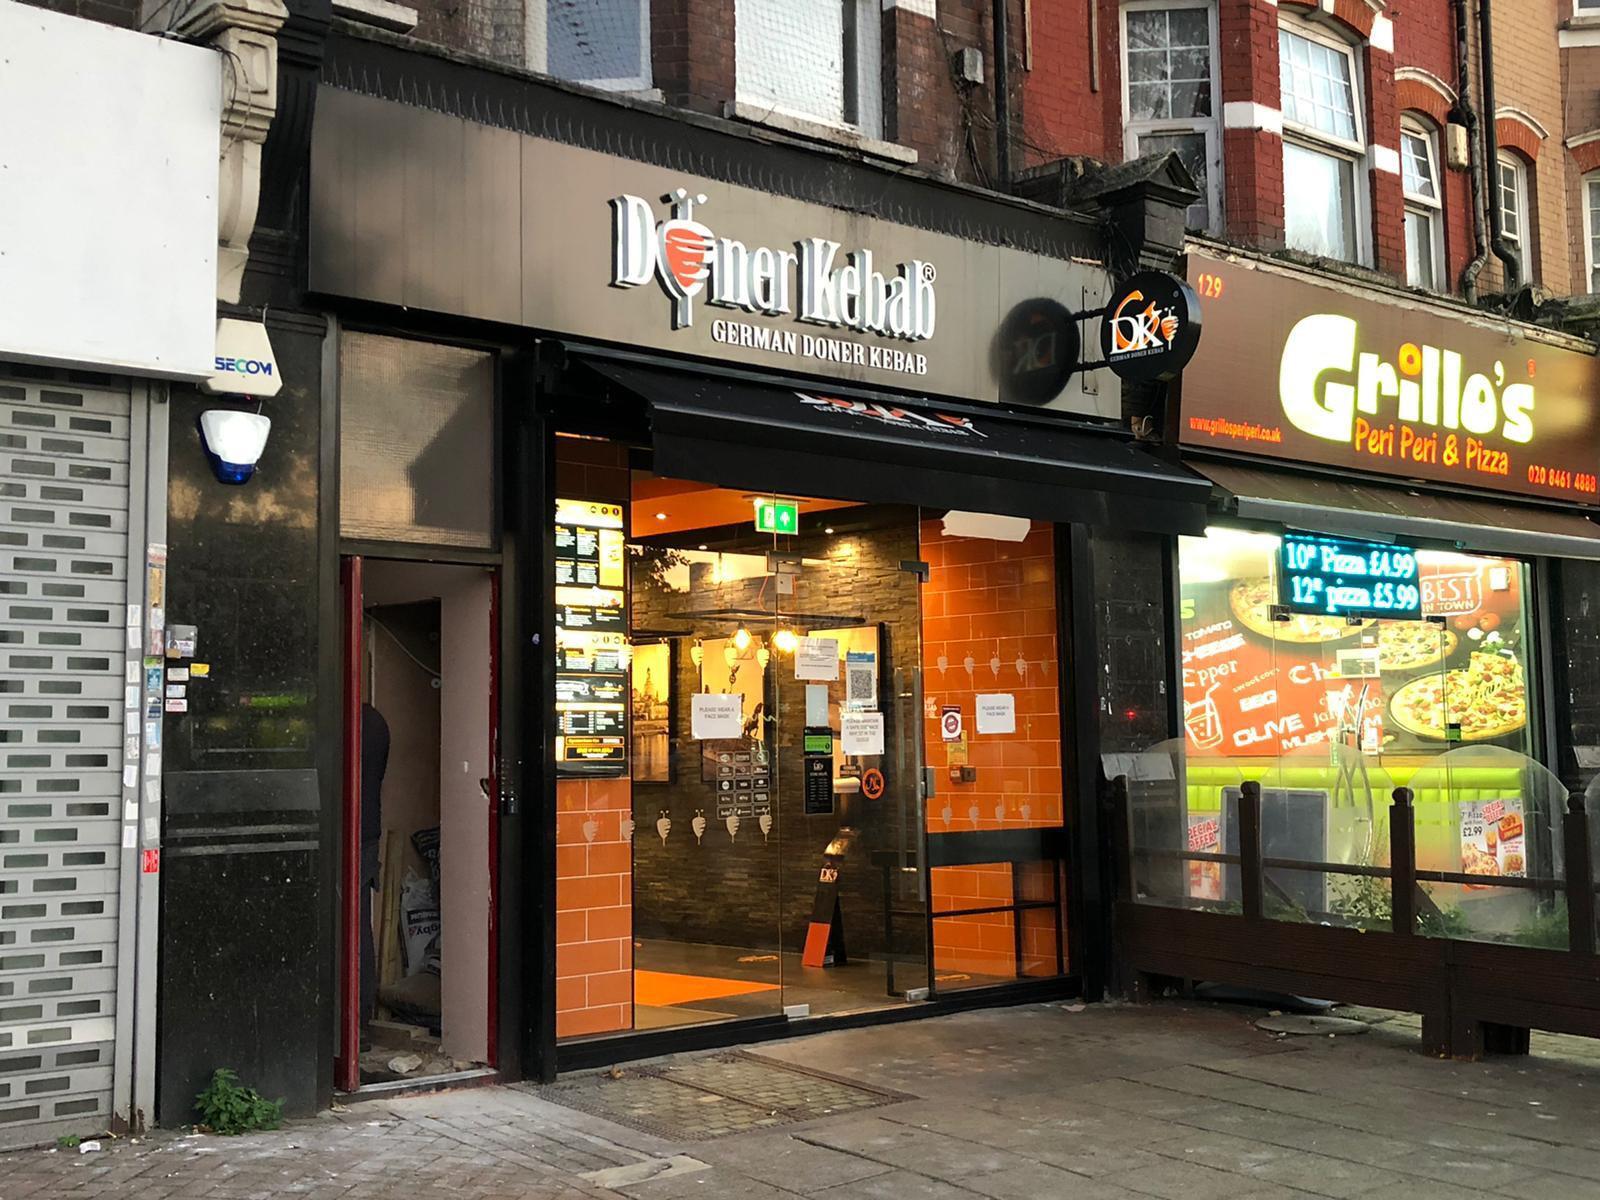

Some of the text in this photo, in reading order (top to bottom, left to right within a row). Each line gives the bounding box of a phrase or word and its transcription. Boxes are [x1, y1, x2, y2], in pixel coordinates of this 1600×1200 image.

[1198, 273, 1223, 299] 129
[711, 318, 928, 376] GERMAN DONER KEBAB
[214, 356, 273, 377] SECOM
[1279, 313, 1536, 444] Grillo's
[1355, 416, 1510, 476] Peri Peri & Pizza
[1527, 463, 1598, 494] 020 8461 4888
[1319, 544, 1368, 576] Pizza
[1369, 550, 1416, 579] £4.99
[1325, 577, 1372, 614] pizza
[1372, 582, 1420, 611] £5.99
[1421, 600, 1475, 613] IN TOWN
[1422, 578, 1474, 603] BEST
[1232, 713, 1304, 748] OLIVE
[1463, 826, 1483, 837] £2.99
